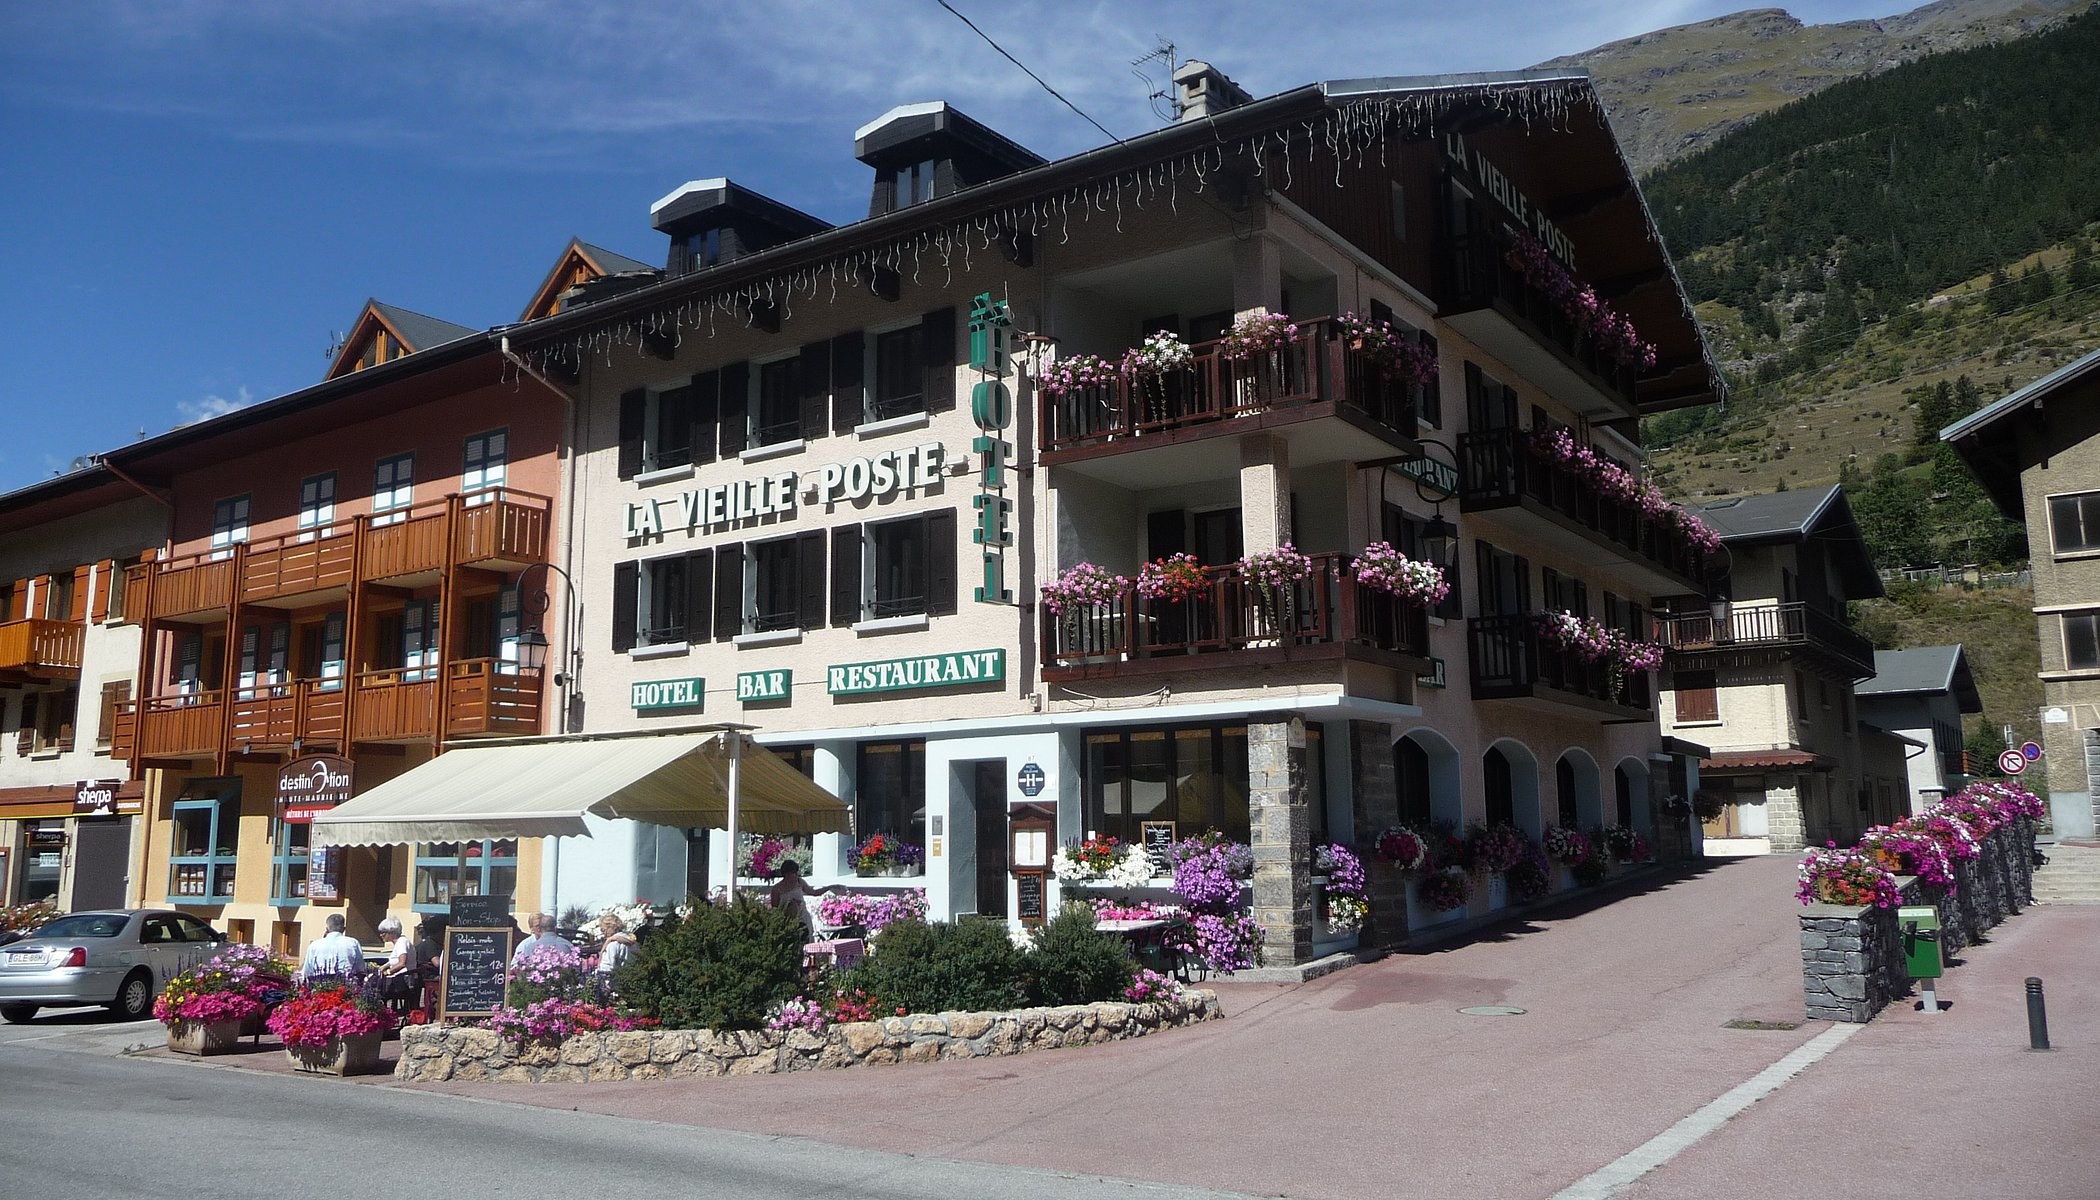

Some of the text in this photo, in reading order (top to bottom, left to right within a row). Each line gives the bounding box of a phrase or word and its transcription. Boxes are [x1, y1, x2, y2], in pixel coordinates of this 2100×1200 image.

[1446, 132, 1577, 273] LA VIEILLE POSTE
[622, 441, 944, 539] LA VIEILLE POSTE
[829, 651, 999, 692] RESTAURANT
[632, 681, 699, 706] HOTEL
[738, 673, 785, 698] BAR
[1026, 774, 1036, 787] H
[77, 786, 112, 806] sherpa
